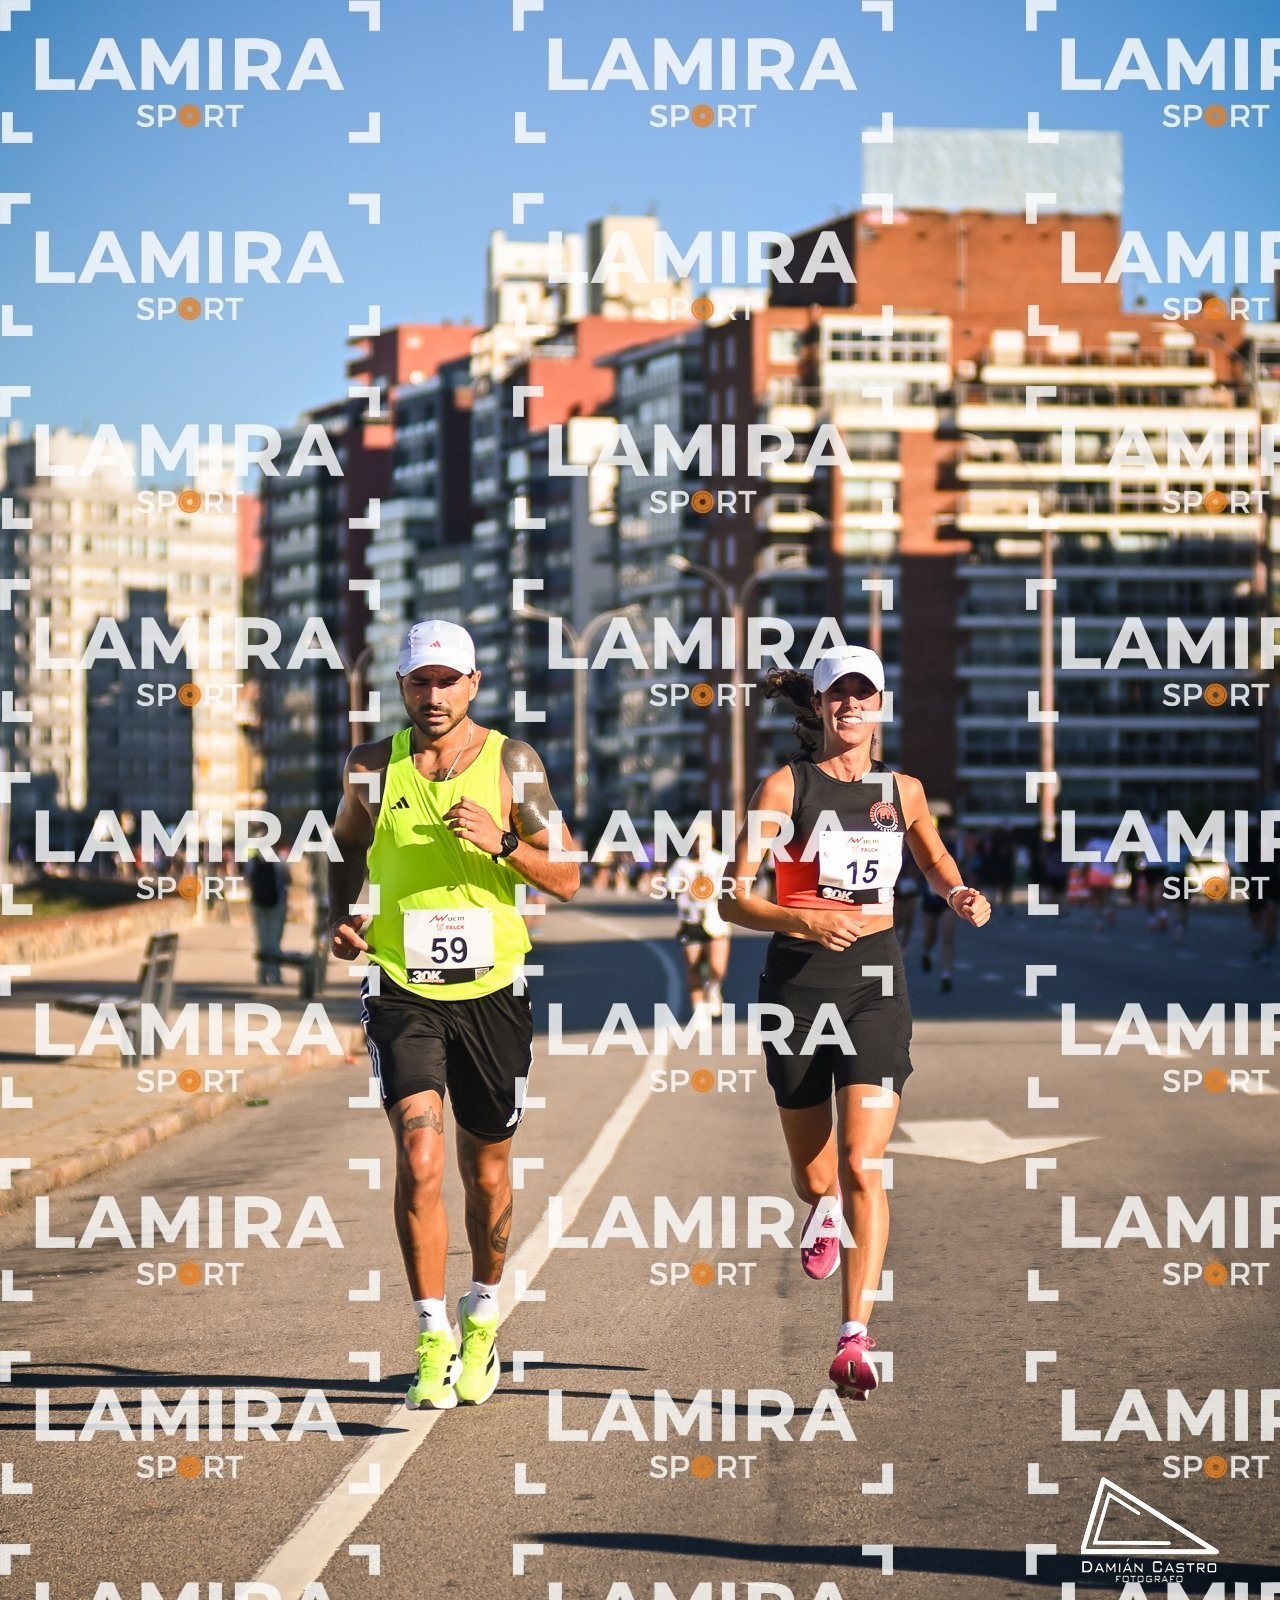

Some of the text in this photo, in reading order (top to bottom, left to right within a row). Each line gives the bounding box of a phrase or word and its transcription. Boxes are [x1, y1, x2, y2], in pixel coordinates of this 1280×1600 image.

[846, 859, 879, 885] 15
[430, 936, 468, 964] 59
[412, 970, 442, 984] 30K
